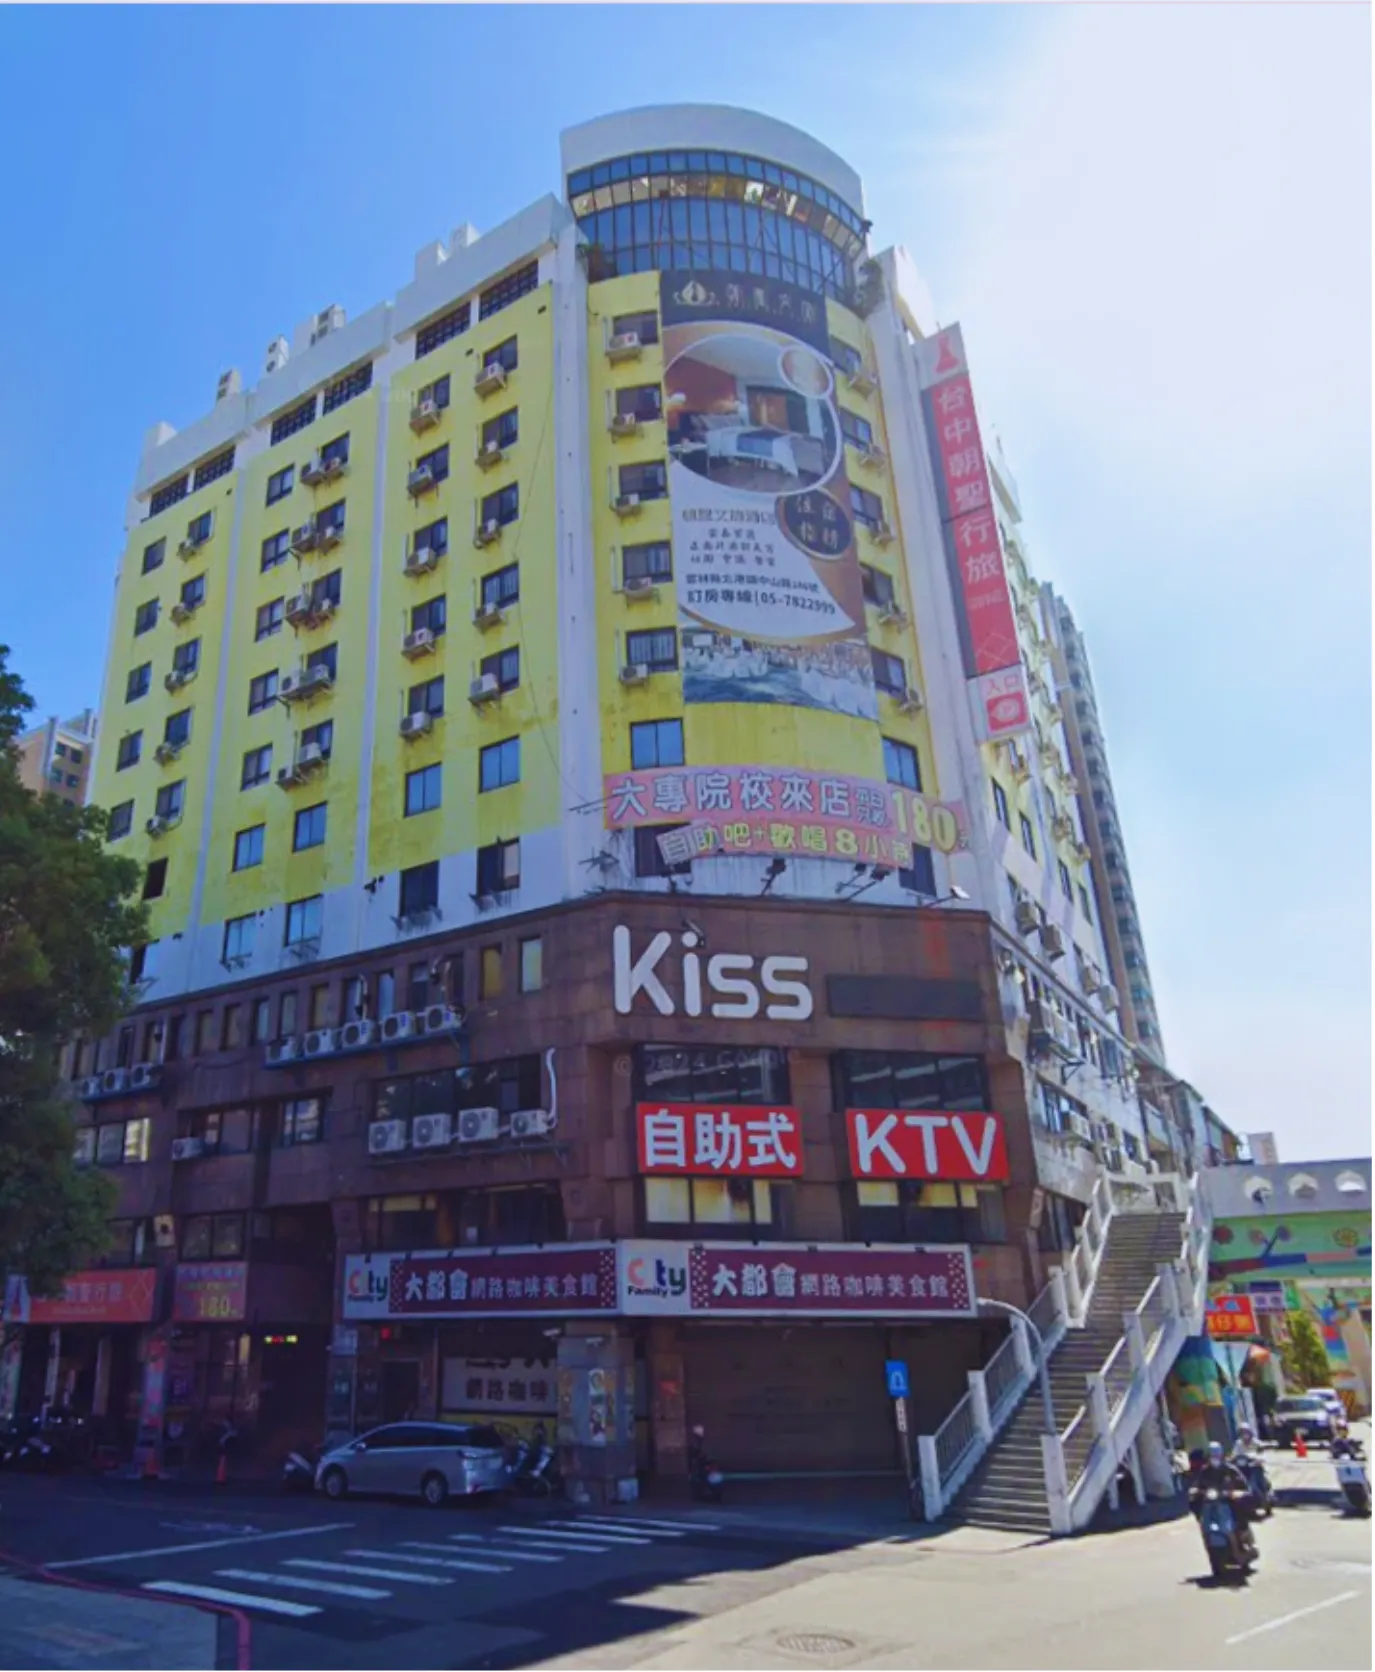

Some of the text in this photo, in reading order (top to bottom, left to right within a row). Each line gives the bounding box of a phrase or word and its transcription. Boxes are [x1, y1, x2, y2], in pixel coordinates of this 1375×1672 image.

[613, 925, 814, 1021] Kiss
[643, 1109, 797, 1170] 自助式
[854, 1112, 997, 1176] KTV
